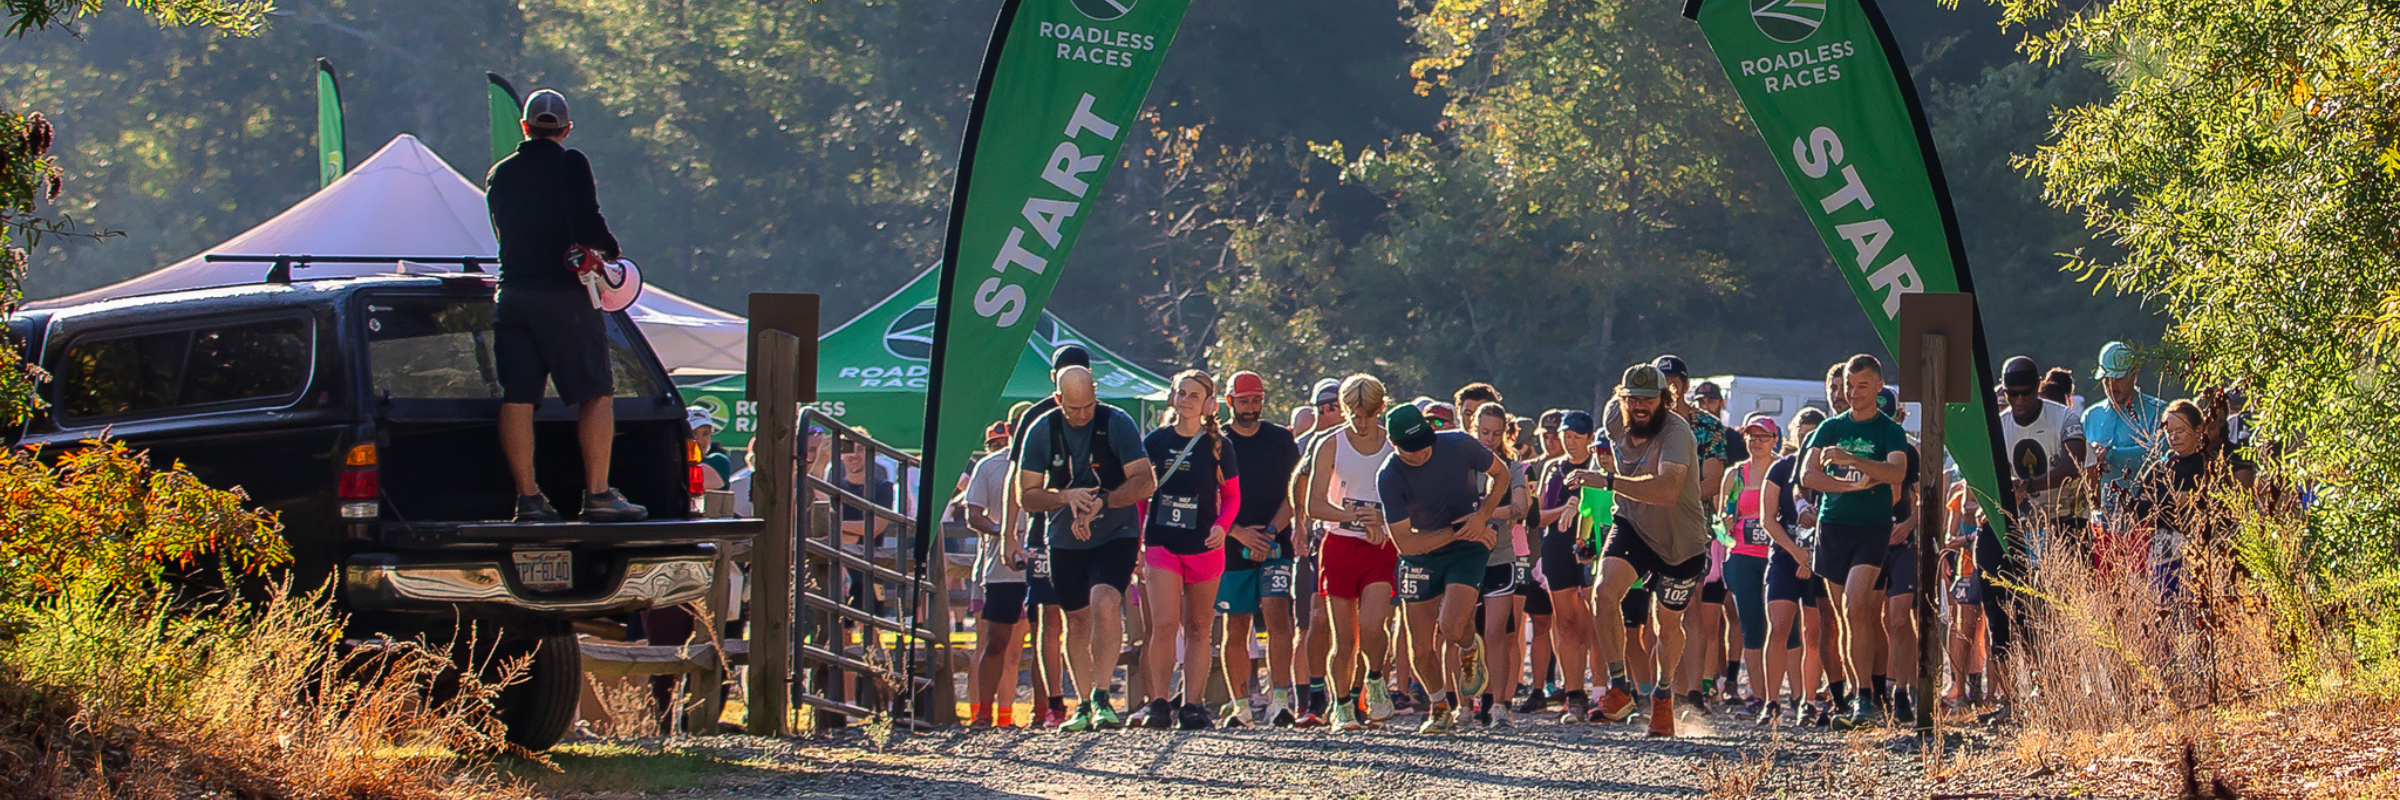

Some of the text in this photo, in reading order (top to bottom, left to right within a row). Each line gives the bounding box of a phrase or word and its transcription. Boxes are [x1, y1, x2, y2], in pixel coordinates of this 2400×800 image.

[1039, 21, 1154, 51] ROADLESS
[1056, 43, 1133, 68] RACES
[1740, 40, 1855, 77] ROADLESS
[1764, 64, 1841, 93] RACES
[973, 92, 1120, 328] START
[1792, 126, 1924, 321] STAR
[838, 365, 929, 378] ROAD
[860, 378, 928, 388] RAC
[1172, 508, 1181, 522] 9
[1752, 528, 1767, 541] 59
[1034, 560, 1050, 574] 30
[1271, 575, 1288, 588] 33
[1401, 580, 1417, 594] 35
[1664, 588, 1689, 601] 102
